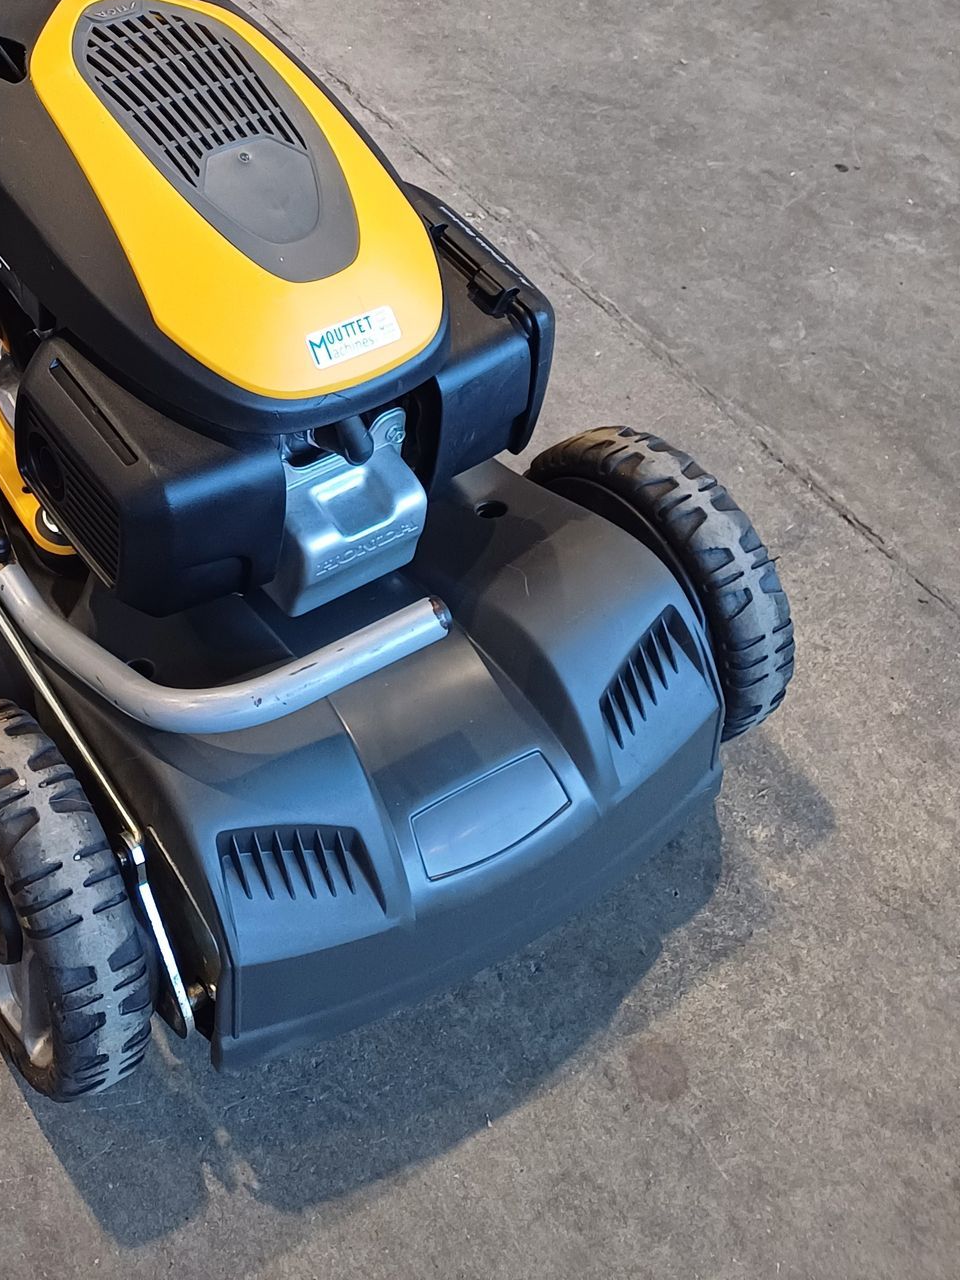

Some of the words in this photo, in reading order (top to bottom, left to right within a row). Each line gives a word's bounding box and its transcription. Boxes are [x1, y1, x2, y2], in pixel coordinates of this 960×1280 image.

[94, 1, 137, 19] STIGA
[308, 315, 373, 365] MOUTTET
[316, 521, 419, 577] HONDA
